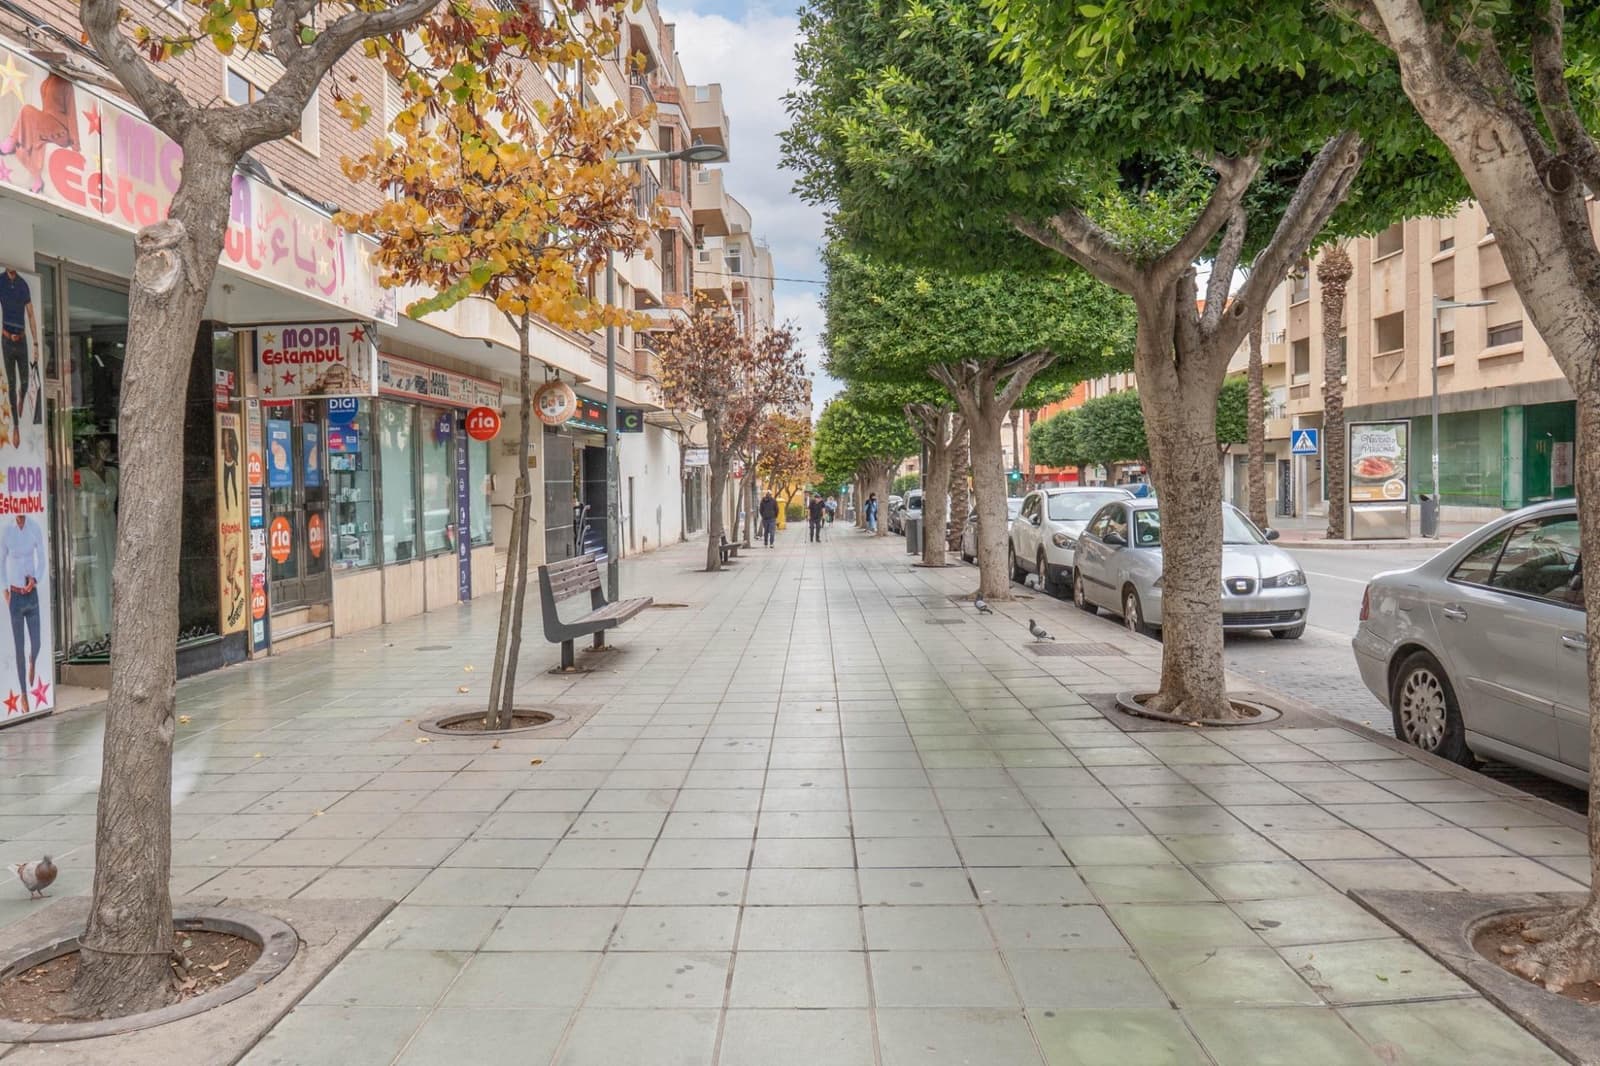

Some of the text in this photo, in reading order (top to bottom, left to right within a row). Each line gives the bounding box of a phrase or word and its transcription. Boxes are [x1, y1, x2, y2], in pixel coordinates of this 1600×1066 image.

[282, 326, 341, 348] MODA
[262, 346, 345, 365] Estambul
[329, 398, 355, 409] DIGI
[470, 412, 495, 429] ria
[8, 466, 42, 493] MODA
[271, 522, 291, 544] ria
